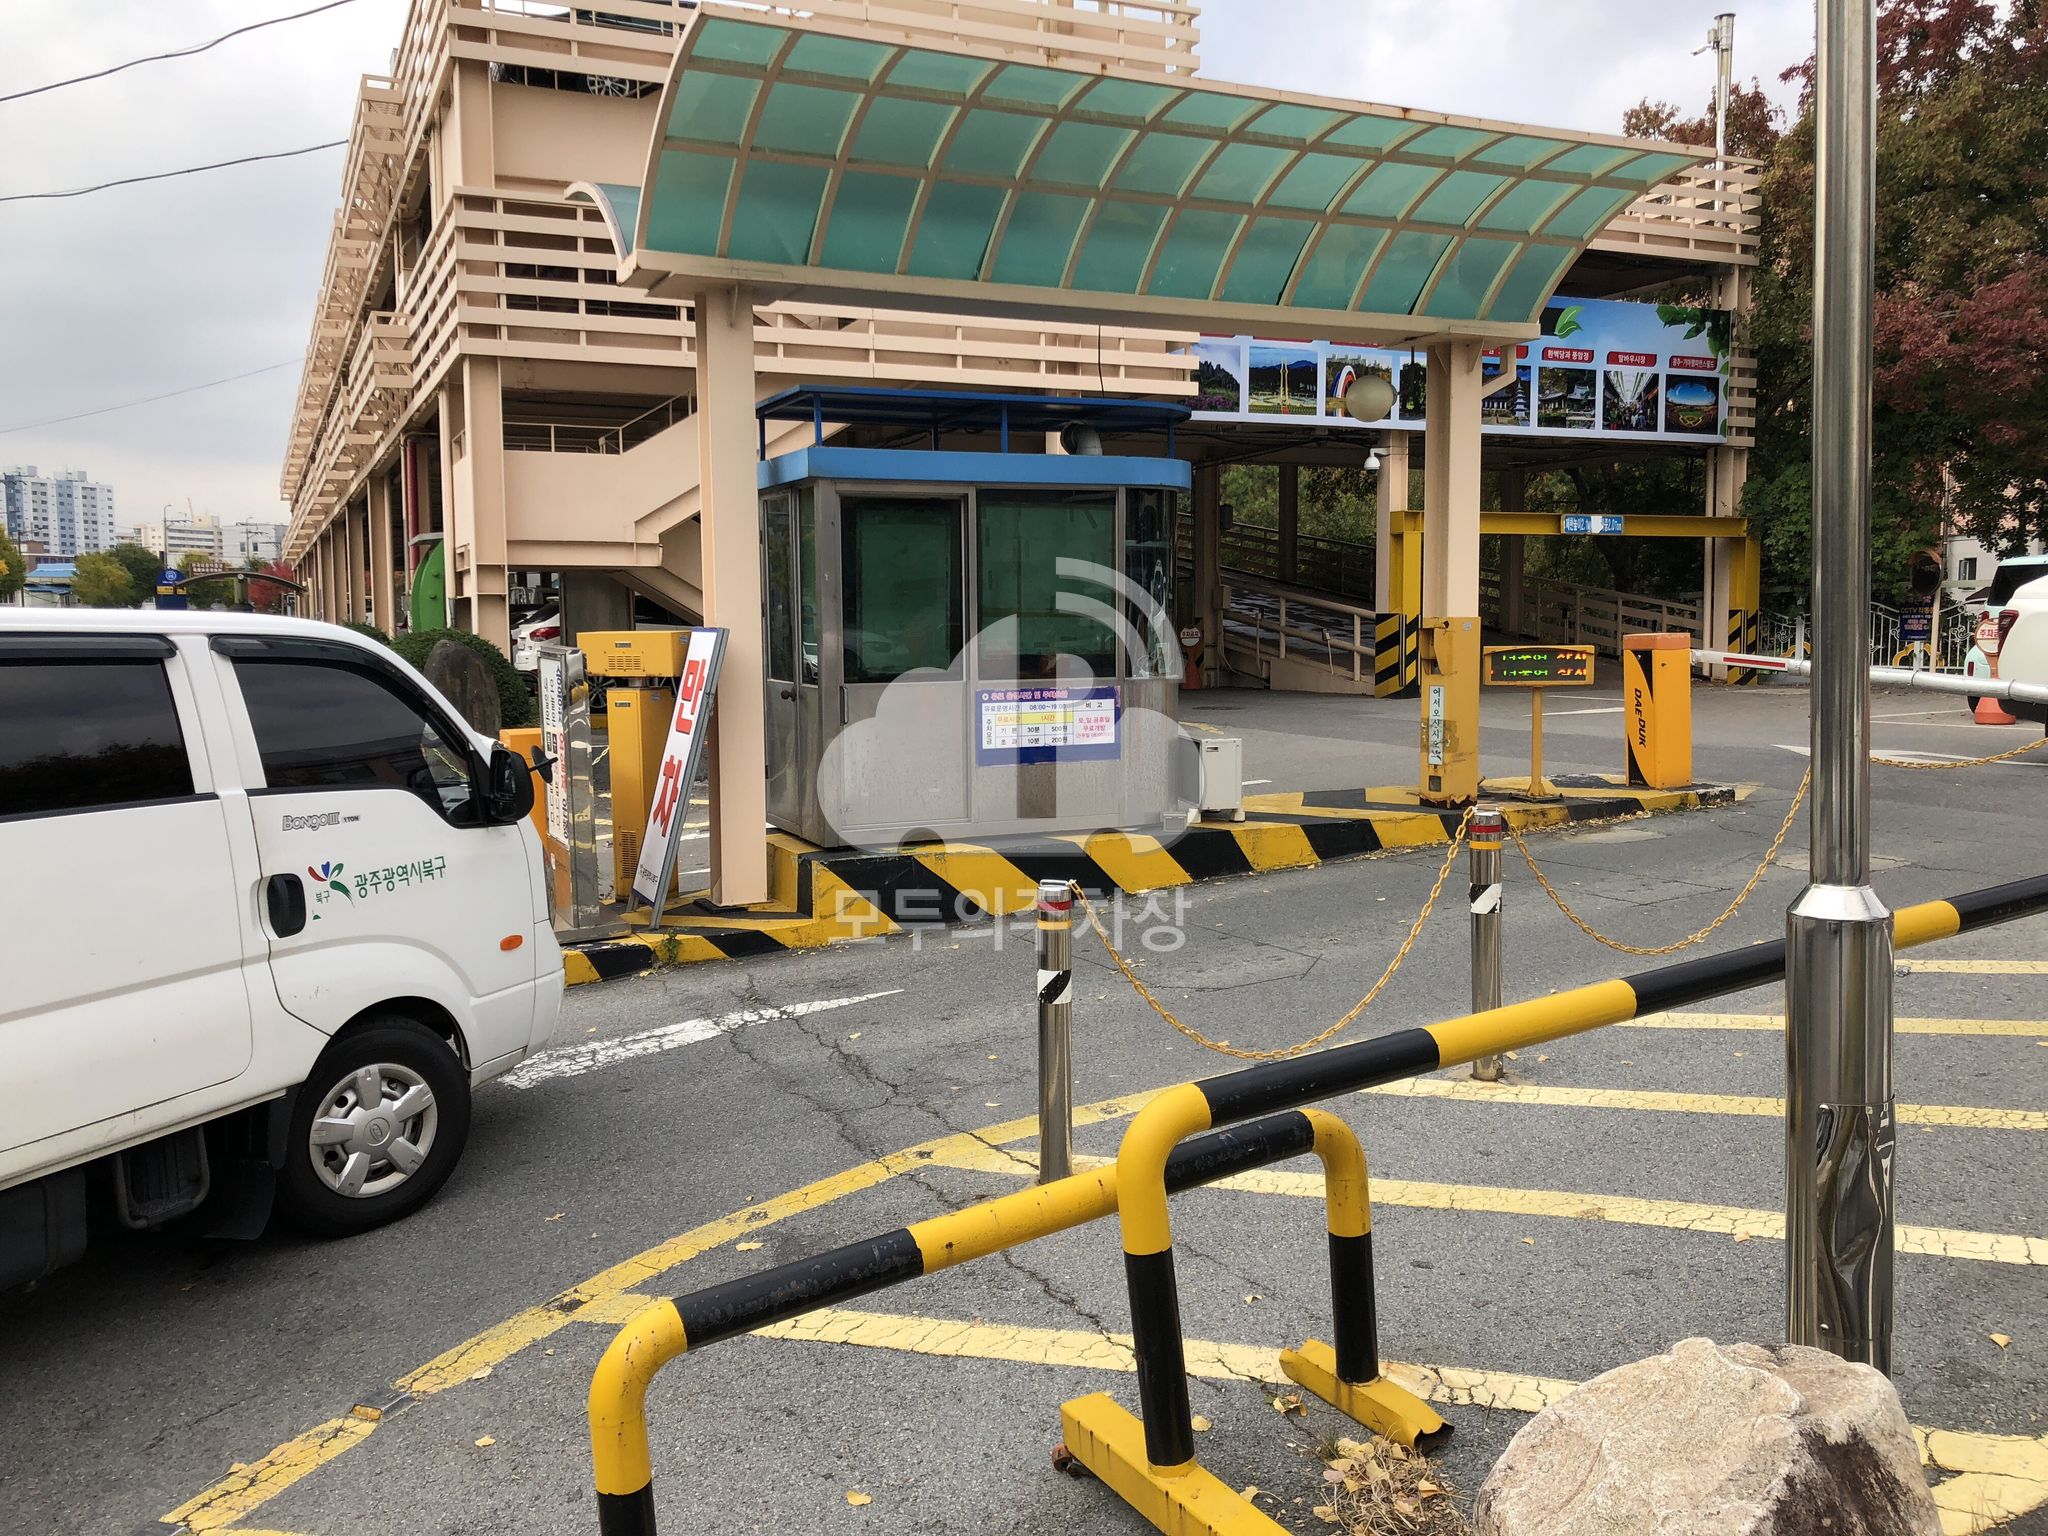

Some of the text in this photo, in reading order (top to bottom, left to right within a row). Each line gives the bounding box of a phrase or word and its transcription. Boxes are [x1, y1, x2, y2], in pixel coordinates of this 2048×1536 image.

[1979, 628, 2001, 638] 주차금
[653, 659, 706, 837] 만차
[315, 890, 331, 904] 북구
